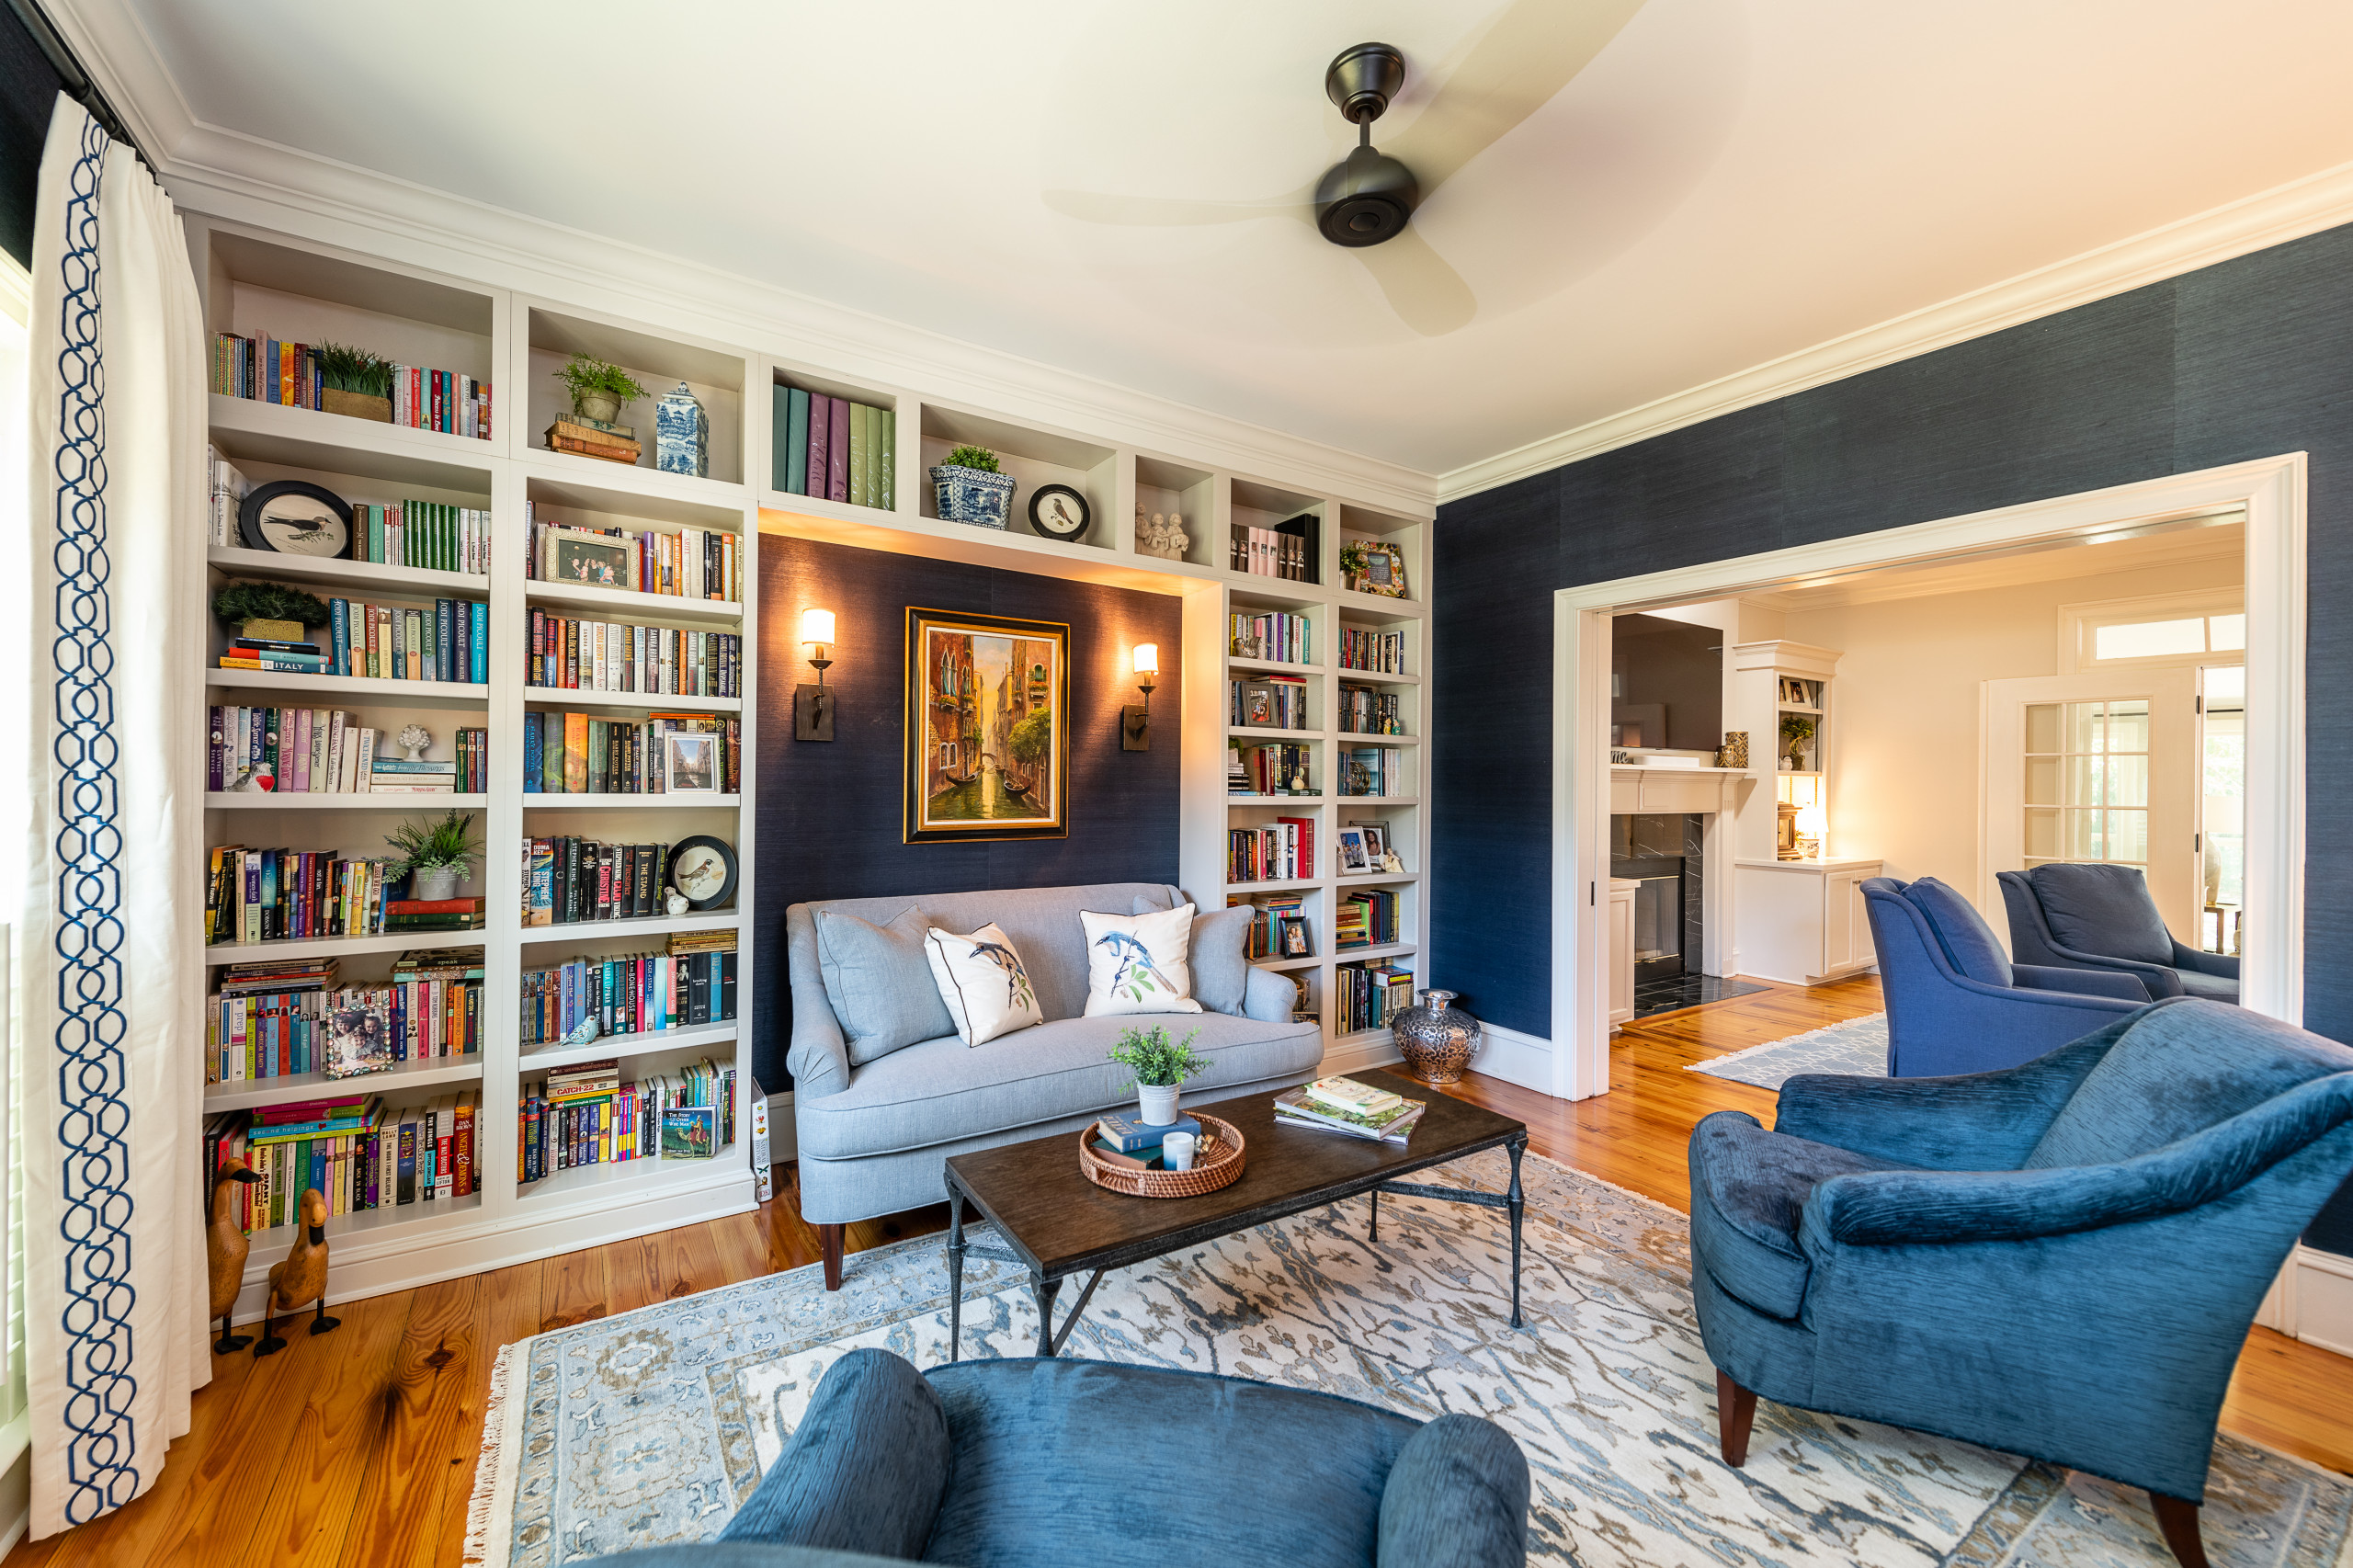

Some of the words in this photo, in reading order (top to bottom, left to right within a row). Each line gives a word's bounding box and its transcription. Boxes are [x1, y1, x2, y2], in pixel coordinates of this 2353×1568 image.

[334, 601, 342, 615] JODI
[440, 601, 448, 617] JODI
[457, 602, 465, 617] JODI
[476, 606, 484, 621] JODI
[335, 617, 343, 643] PICOULT
[533, 612, 543, 634] SANDRA
[569, 621, 577, 638] SANDRA
[533, 635, 543, 655] BROWN
[610, 625, 619, 645] SANDRA
[533, 656, 543, 672] smash
[610, 646, 619, 663] BROWN
[541, 871, 549, 899] STEPHEN
[598, 866, 612, 903] CHRISTINE
[613, 881, 622, 901] CUJO
[640, 876, 648, 899] STAND
[557, 1084, 594, 1095] CATCH-22
[459, 1132, 468, 1154] ANGELS
[457, 1153, 470, 1164] &
[458, 1163, 468, 1187] DEMONS
